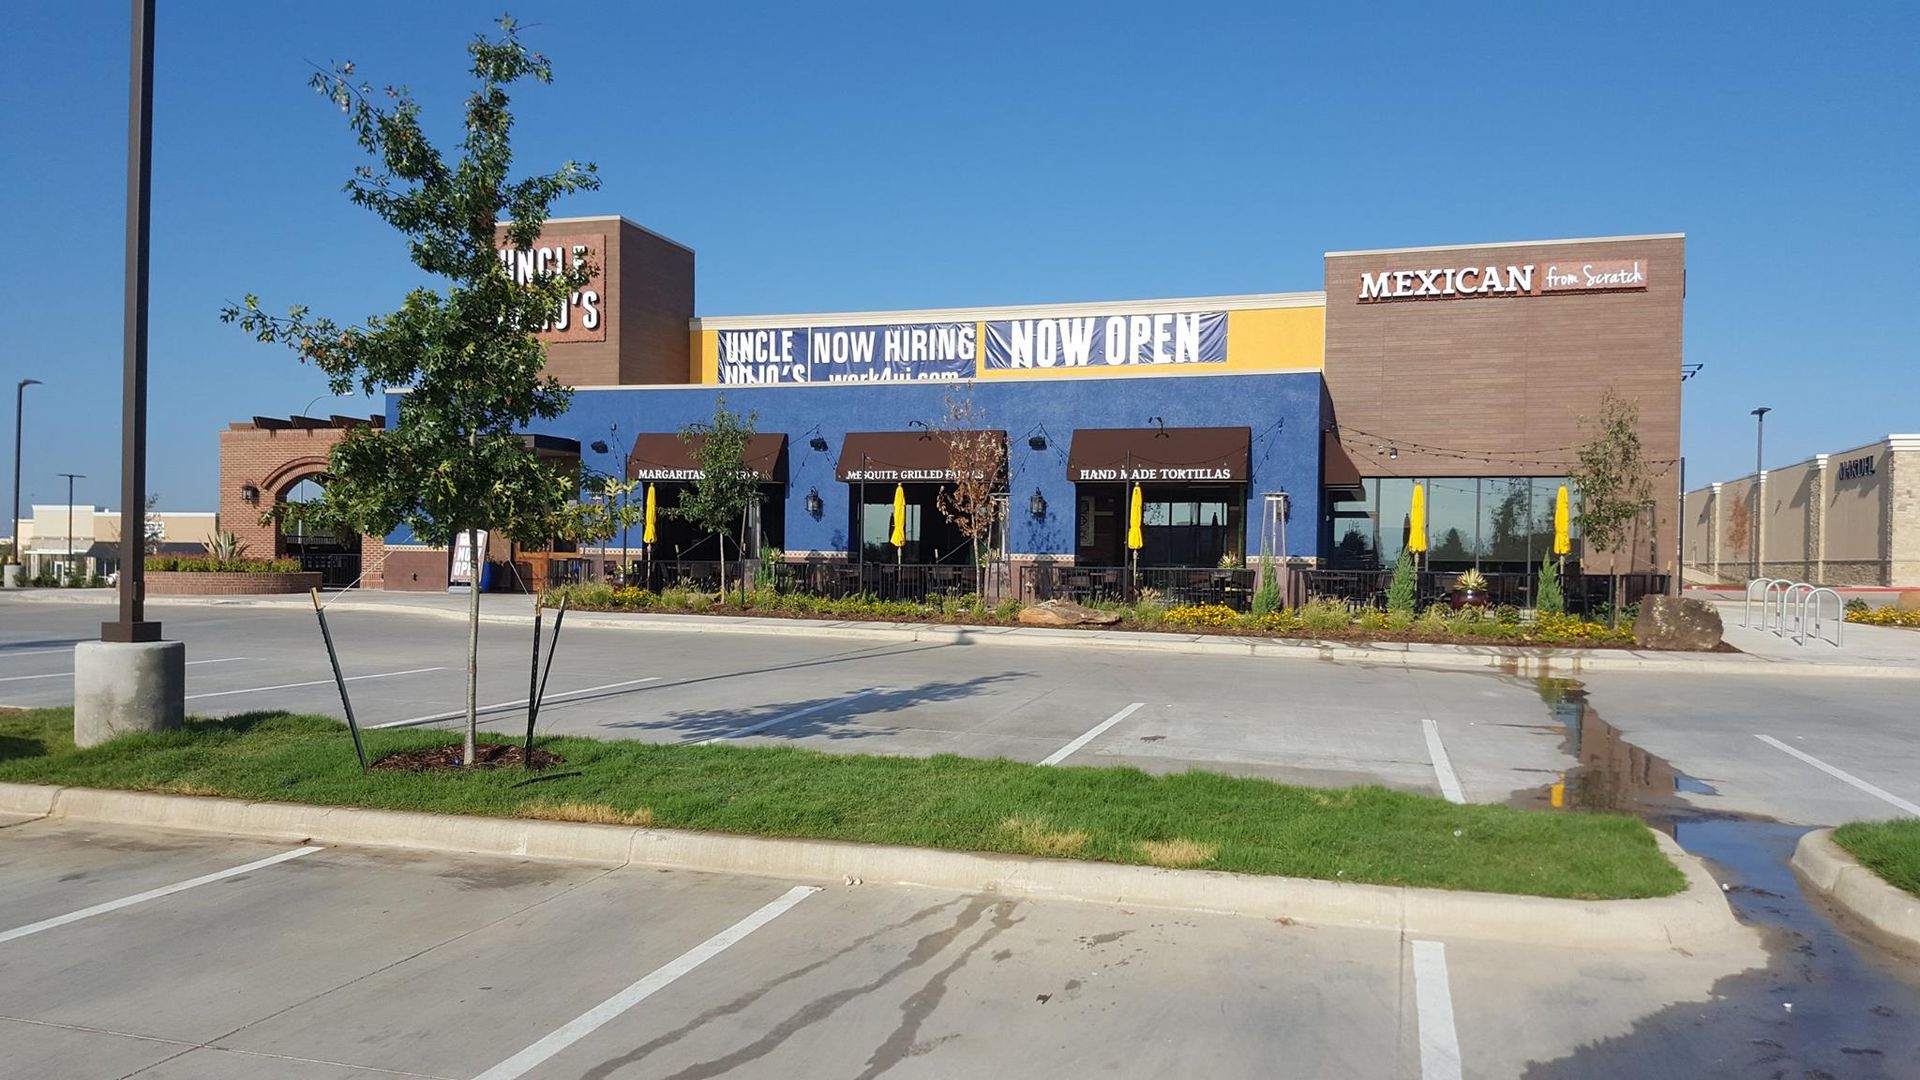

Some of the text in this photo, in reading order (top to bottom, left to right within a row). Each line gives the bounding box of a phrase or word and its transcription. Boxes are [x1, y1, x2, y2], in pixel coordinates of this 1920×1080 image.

[499, 246, 586, 285] UNCLE
[1359, 262, 1643, 299] MEXICAN from Scratch
[726, 330, 793, 363] UNCLE
[814, 327, 976, 364] NOW HIRING
[1011, 314, 1200, 370] NOW OPEN
[638, 469, 706, 480] MARGARITAS
[846, 470, 898, 480] MESQUITE
[901, 470, 944, 479] GRILLED
[1080, 469, 1231, 480] HAND MADE TORTILLAS
